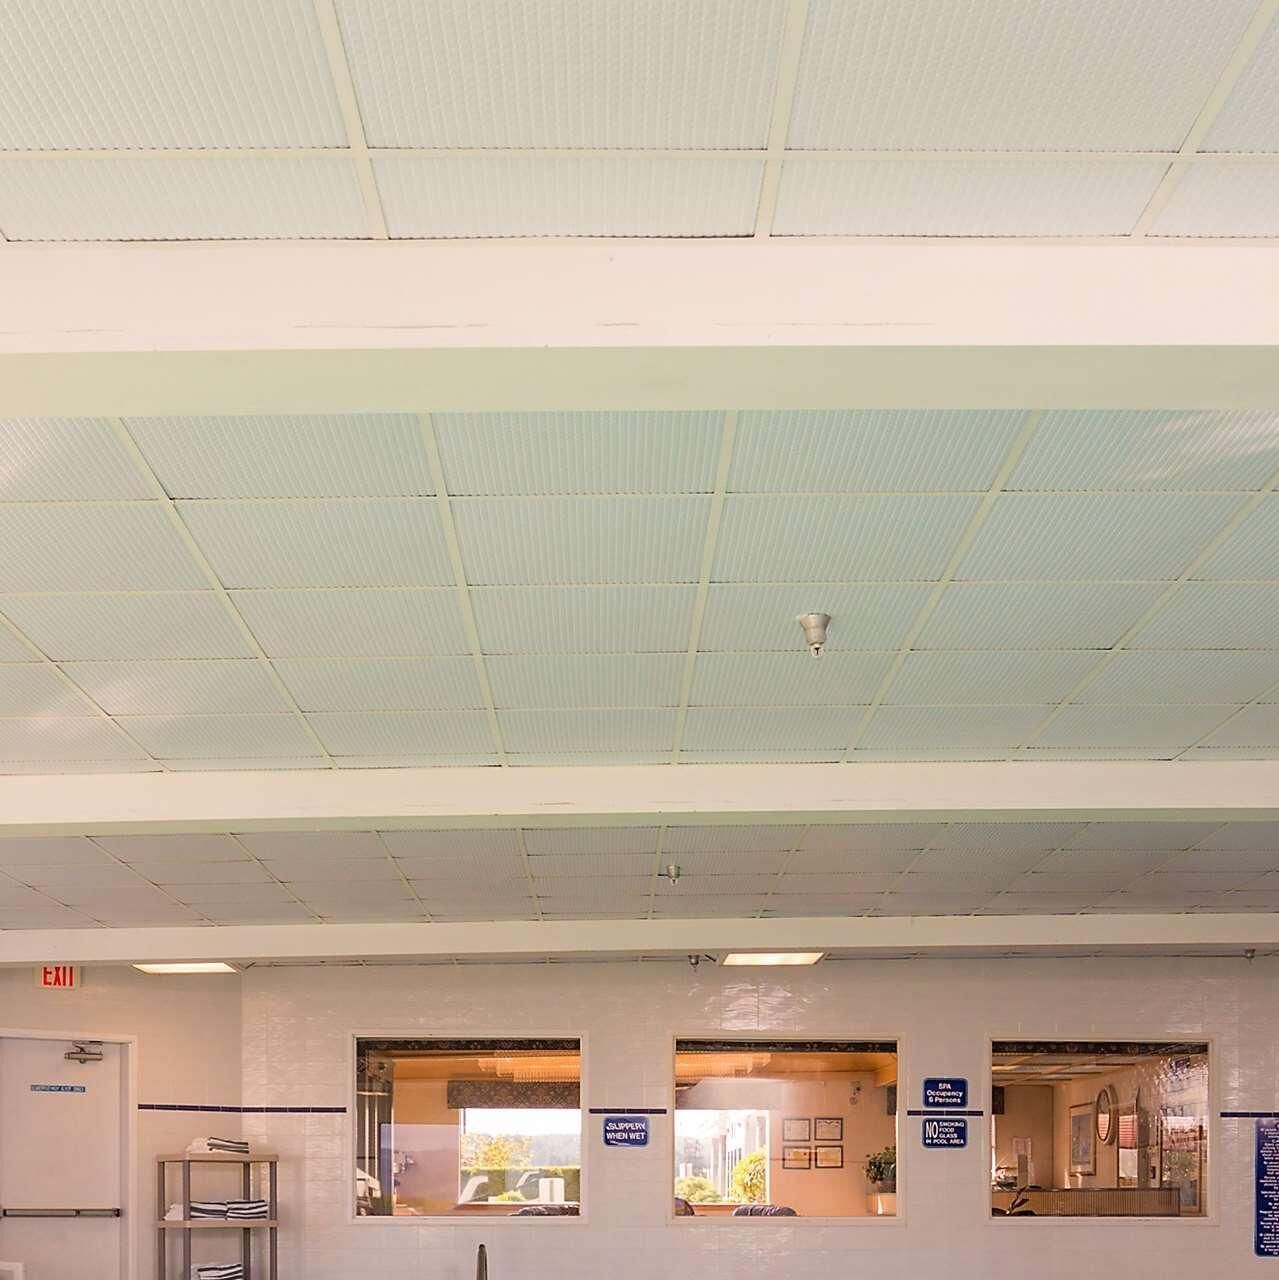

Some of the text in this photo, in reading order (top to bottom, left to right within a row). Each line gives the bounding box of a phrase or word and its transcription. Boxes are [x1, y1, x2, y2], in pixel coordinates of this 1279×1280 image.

[927, 1090, 963, 1098] Occupancy
[608, 1122, 646, 1130] SLIPPERY
[926, 1121, 939, 1138] NO
[606, 1132, 646, 1140] WHEN WET
